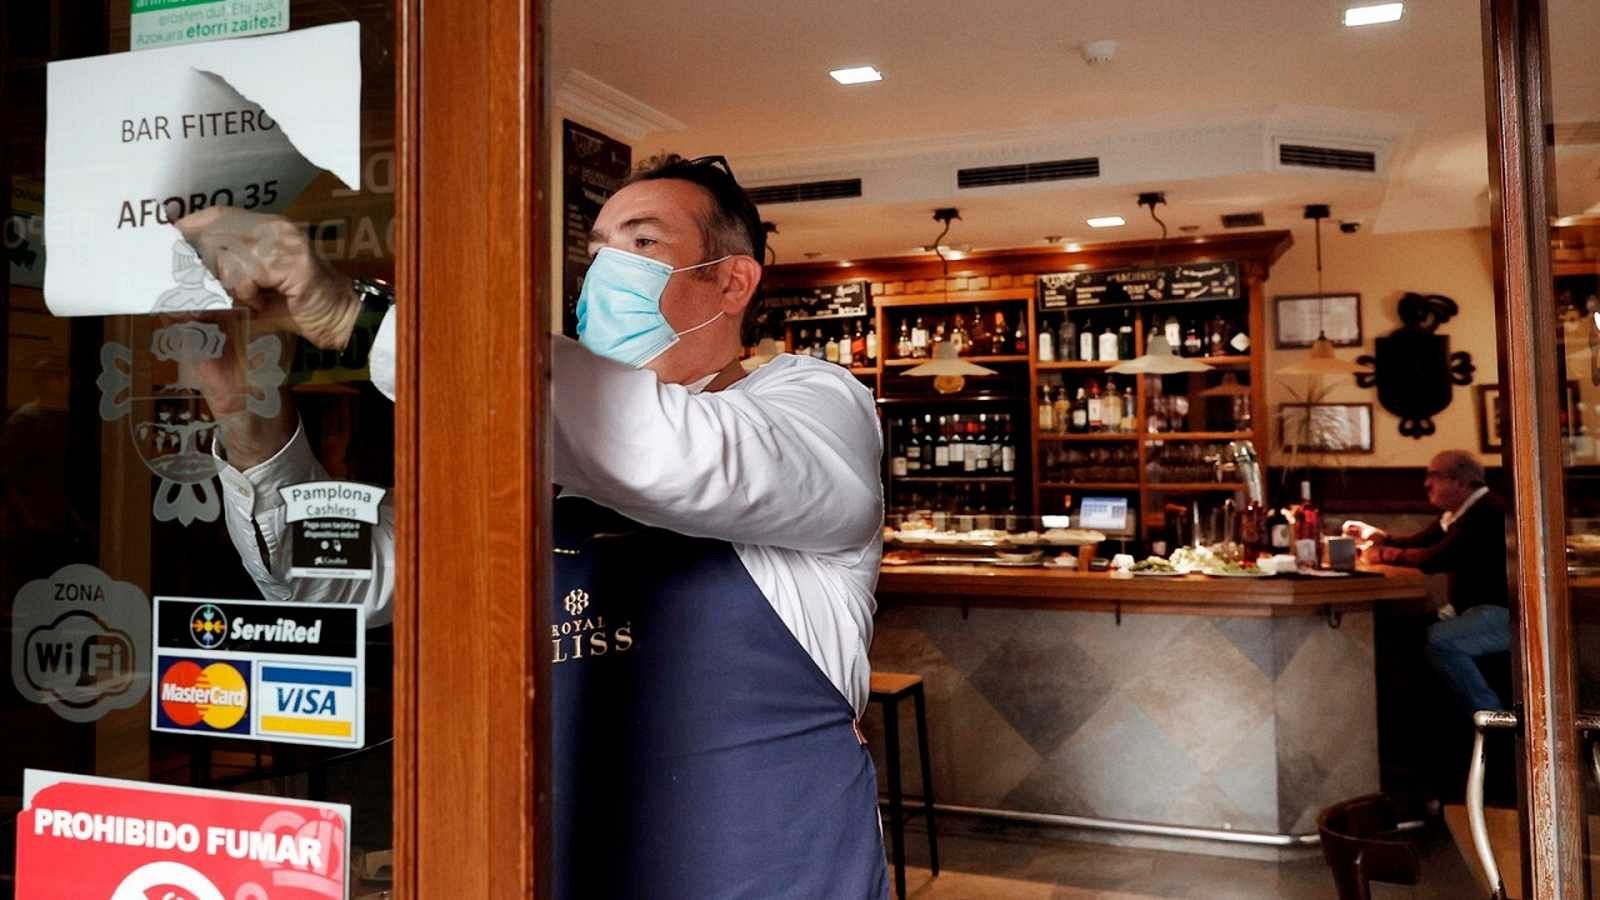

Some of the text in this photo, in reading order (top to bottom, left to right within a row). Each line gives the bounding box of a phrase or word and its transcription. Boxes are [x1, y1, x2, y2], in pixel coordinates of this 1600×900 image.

[186, 21, 227, 38] etorri
[231, 11, 282, 33] zaitez!
[121, 109, 275, 143] BAR FITERO
[243, 180, 278, 210] 35
[292, 484, 372, 503] Pamplona
[306, 503, 357, 517] Cashless
[54, 583, 104, 602] ZONA
[231, 617, 322, 644] ServiRed
[552, 621, 633, 663] LISS
[161, 683, 246, 707] MasterCard
[276, 686, 337, 716] VISA
[34, 808, 323, 868] PROHIBIDO FUMAR
